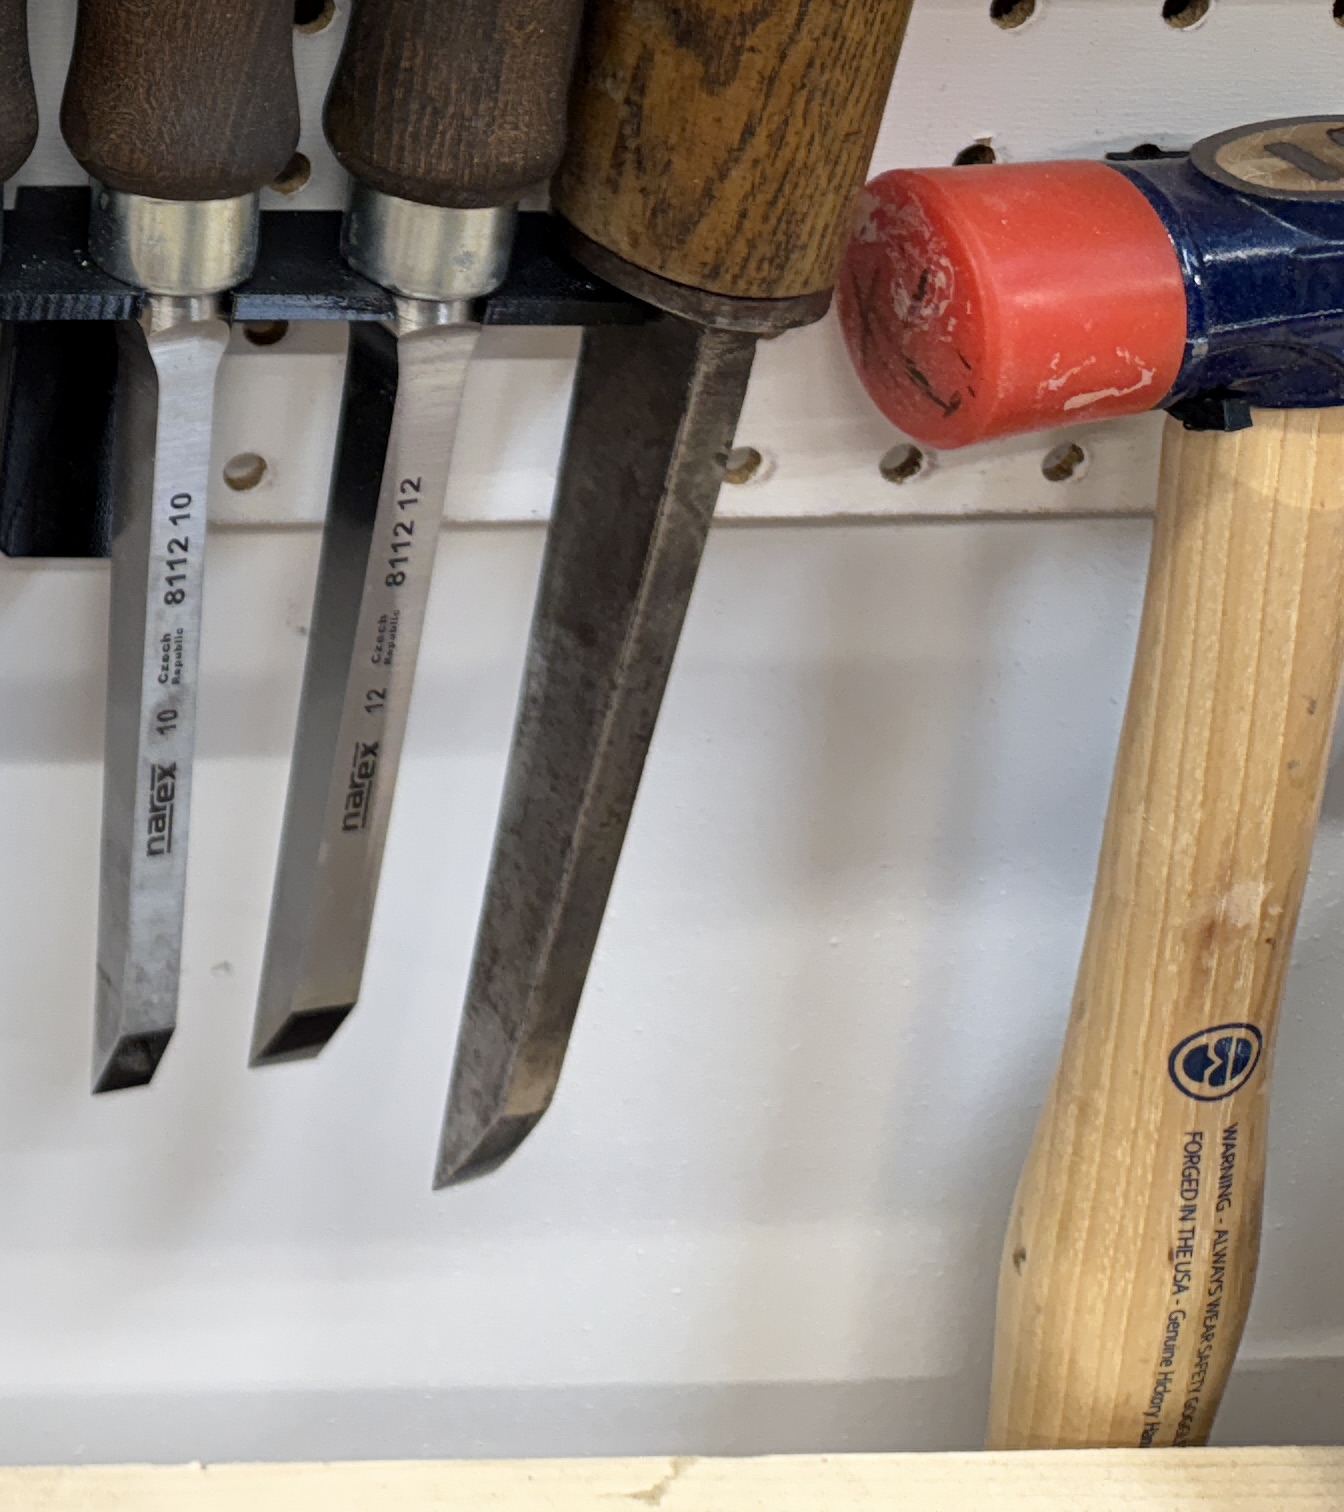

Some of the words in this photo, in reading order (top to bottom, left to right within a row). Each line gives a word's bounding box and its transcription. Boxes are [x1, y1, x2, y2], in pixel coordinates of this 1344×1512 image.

[169, 492, 193, 526] 10
[398, 476, 423, 510] 12
[164, 536, 189, 605] 8112
[385, 520, 415, 587] 8112
[158, 632, 171, 685] Czech
[155, 708, 178, 736] 10
[343, 741, 379, 831] narex
[364, 687, 387, 715] 12
[146, 762, 177, 857] narex
[1180, 1131, 1203, 1202] FORGED
[1215, 1121, 1239, 1213] WARNING
[1178, 1203, 1197, 1222] IN
[1175, 1225, 1196, 1260] THE
[1208, 1229, 1229, 1297] ALWAYS
[1171, 1260, 1191, 1296] USA
[1159, 1310, 1186, 1367] Genuine
[1200, 1297, 1221, 1341] WEAR
[1143, 1370, 1175, 1417] Hickory
